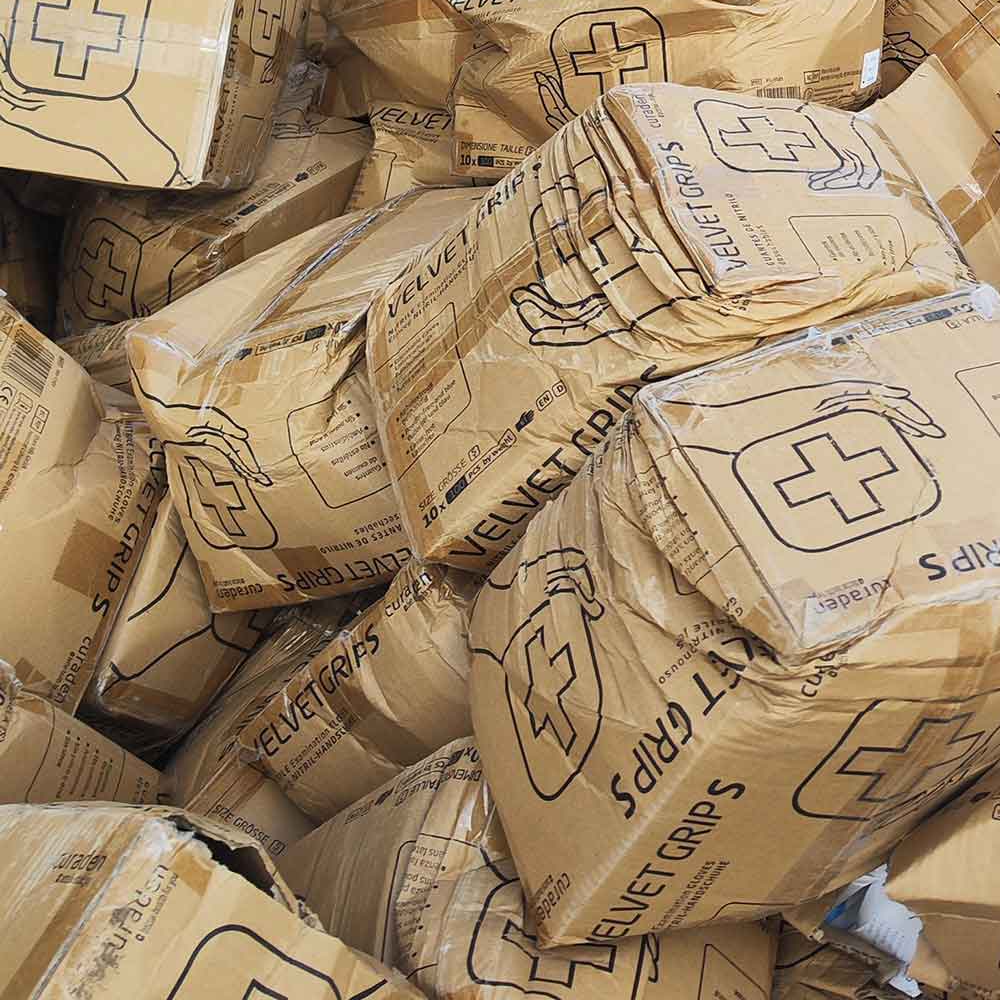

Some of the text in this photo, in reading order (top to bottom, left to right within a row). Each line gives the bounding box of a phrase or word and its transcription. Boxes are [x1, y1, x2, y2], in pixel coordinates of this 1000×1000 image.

[460, 154, 477, 166] 10x
[500, 143, 524, 154] TAILLE
[658, 140, 748, 271] VELVET GRIPS
[388, 226, 469, 318] VELVET
[538, 393, 551, 407] EN
[418, 490, 437, 511] SIZE
[421, 503, 447, 528] 10x
[467, 464, 482, 480] PCS
[449, 447, 578, 557] VELVET
[91, 437, 169, 617] ELVET GRIPS
[319, 523, 402, 554] ANTES DE NITRILO
[354, 513, 402, 536] sechables
[276, 547, 413, 593] ELVET GRIPS
[54, 635, 92, 705] curaden
[253, 679, 324, 760] VELVET
[318, 623, 380, 694] GRIPS
[463, 747, 481, 762] 0x
[611, 701, 693, 820] GRIPS
[212, 803, 233, 823] SIZE
[585, 778, 746, 944] ELVET GRIPS
[686, 860, 716, 890] GLOVES
[535, 872, 572, 928] curade
[667, 858, 731, 929] TRIL-HANDSCHUHE
